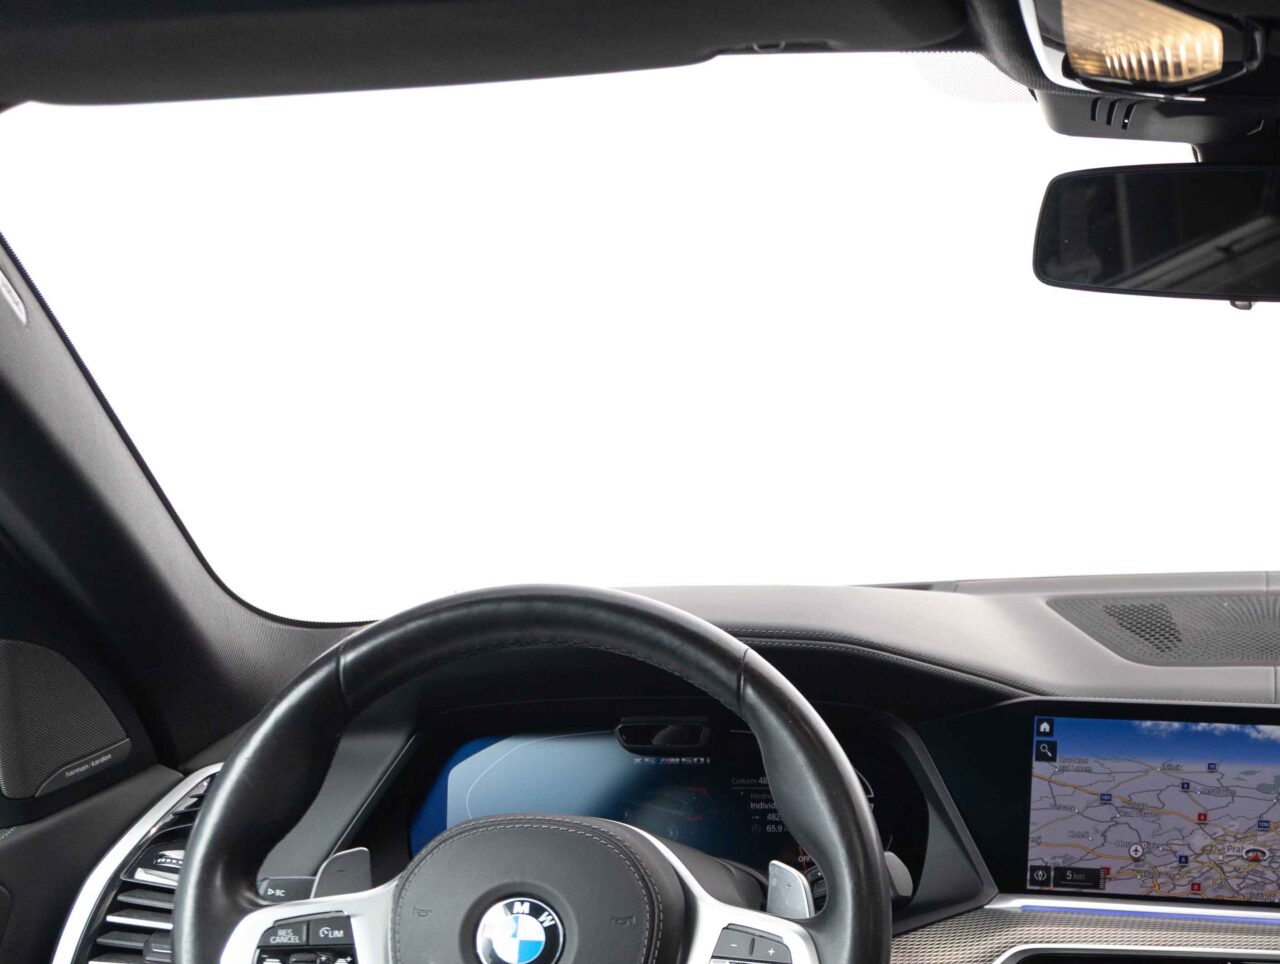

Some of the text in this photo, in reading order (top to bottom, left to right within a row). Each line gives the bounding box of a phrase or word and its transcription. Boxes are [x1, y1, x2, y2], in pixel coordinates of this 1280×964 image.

[1066, 871, 1085, 880] 5 km
[329, 930, 344, 938] LIM
[270, 936, 299, 944] CANCEL
